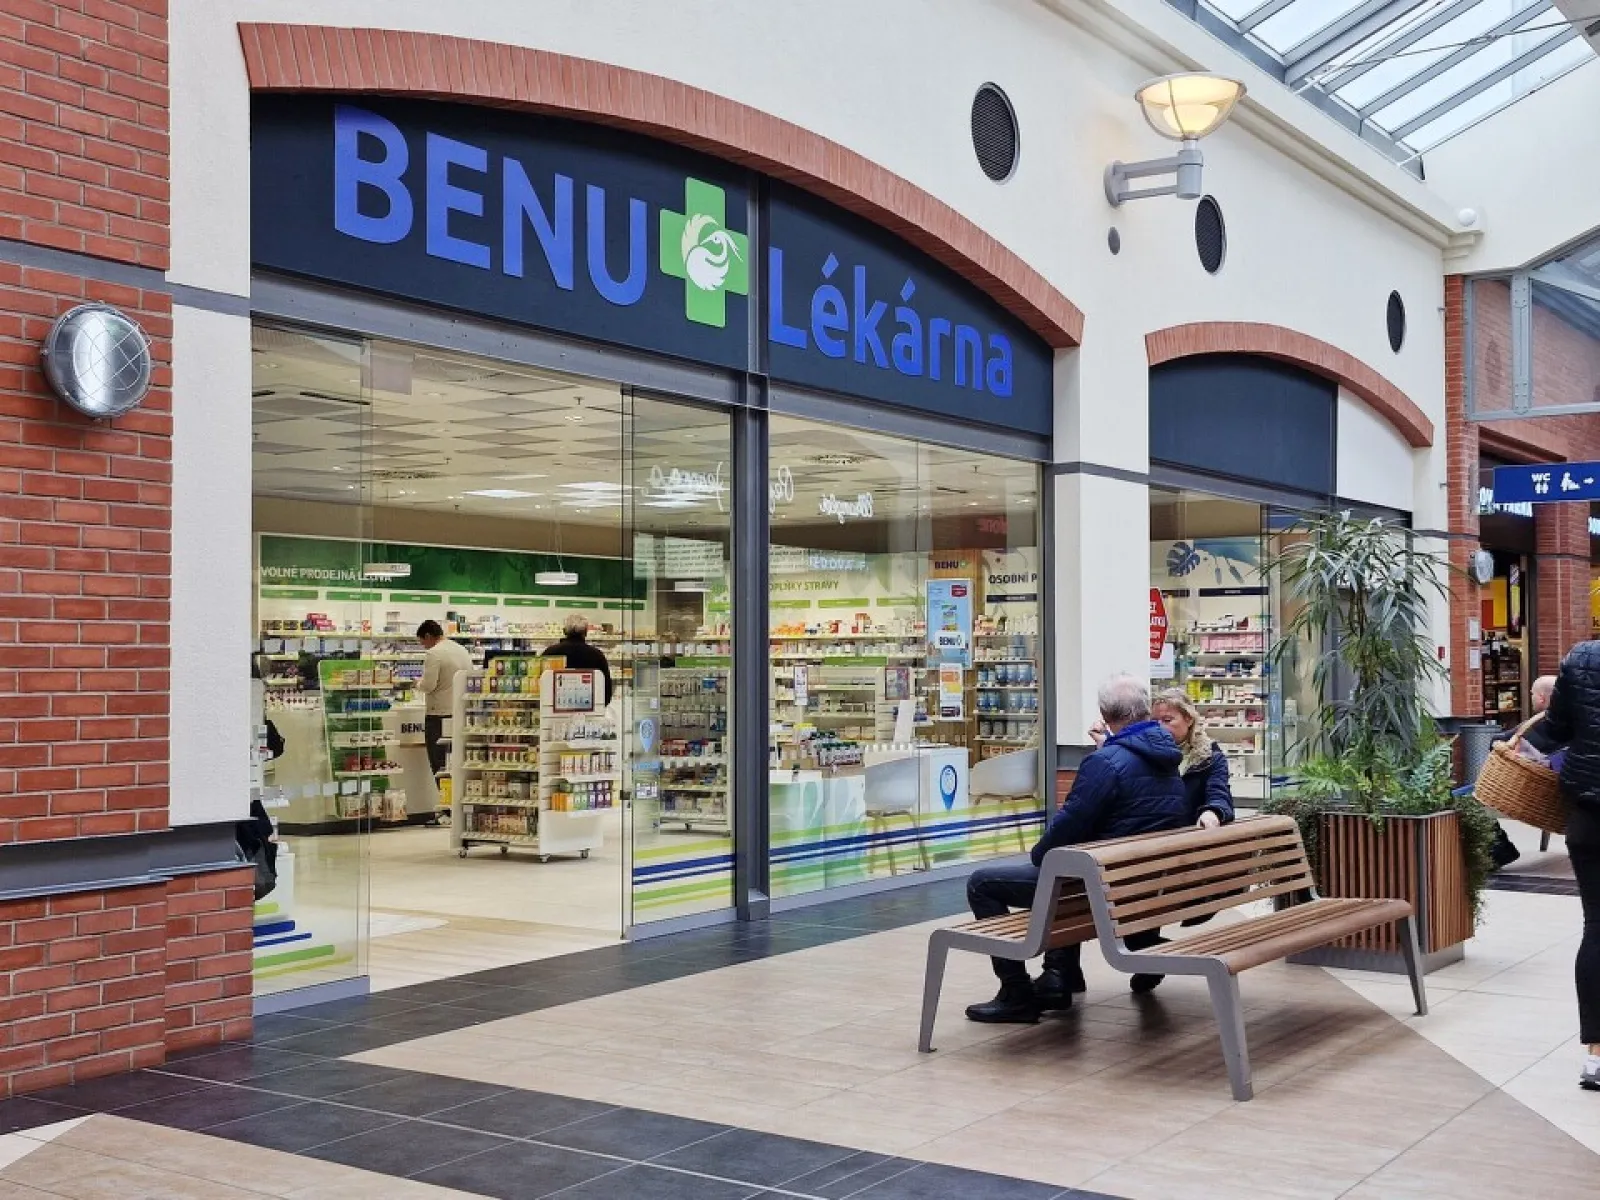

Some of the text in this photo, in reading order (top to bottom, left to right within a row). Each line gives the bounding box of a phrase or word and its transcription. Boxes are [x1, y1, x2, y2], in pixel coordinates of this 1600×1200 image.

[334, 103, 1013, 398] BENU Lékárna
[1531, 472, 1551, 483] WC
[934, 561, 959, 569] BENU
[988, 571, 1029, 584] OSOBNÍ
[804, 580, 839, 591] STRAVY
